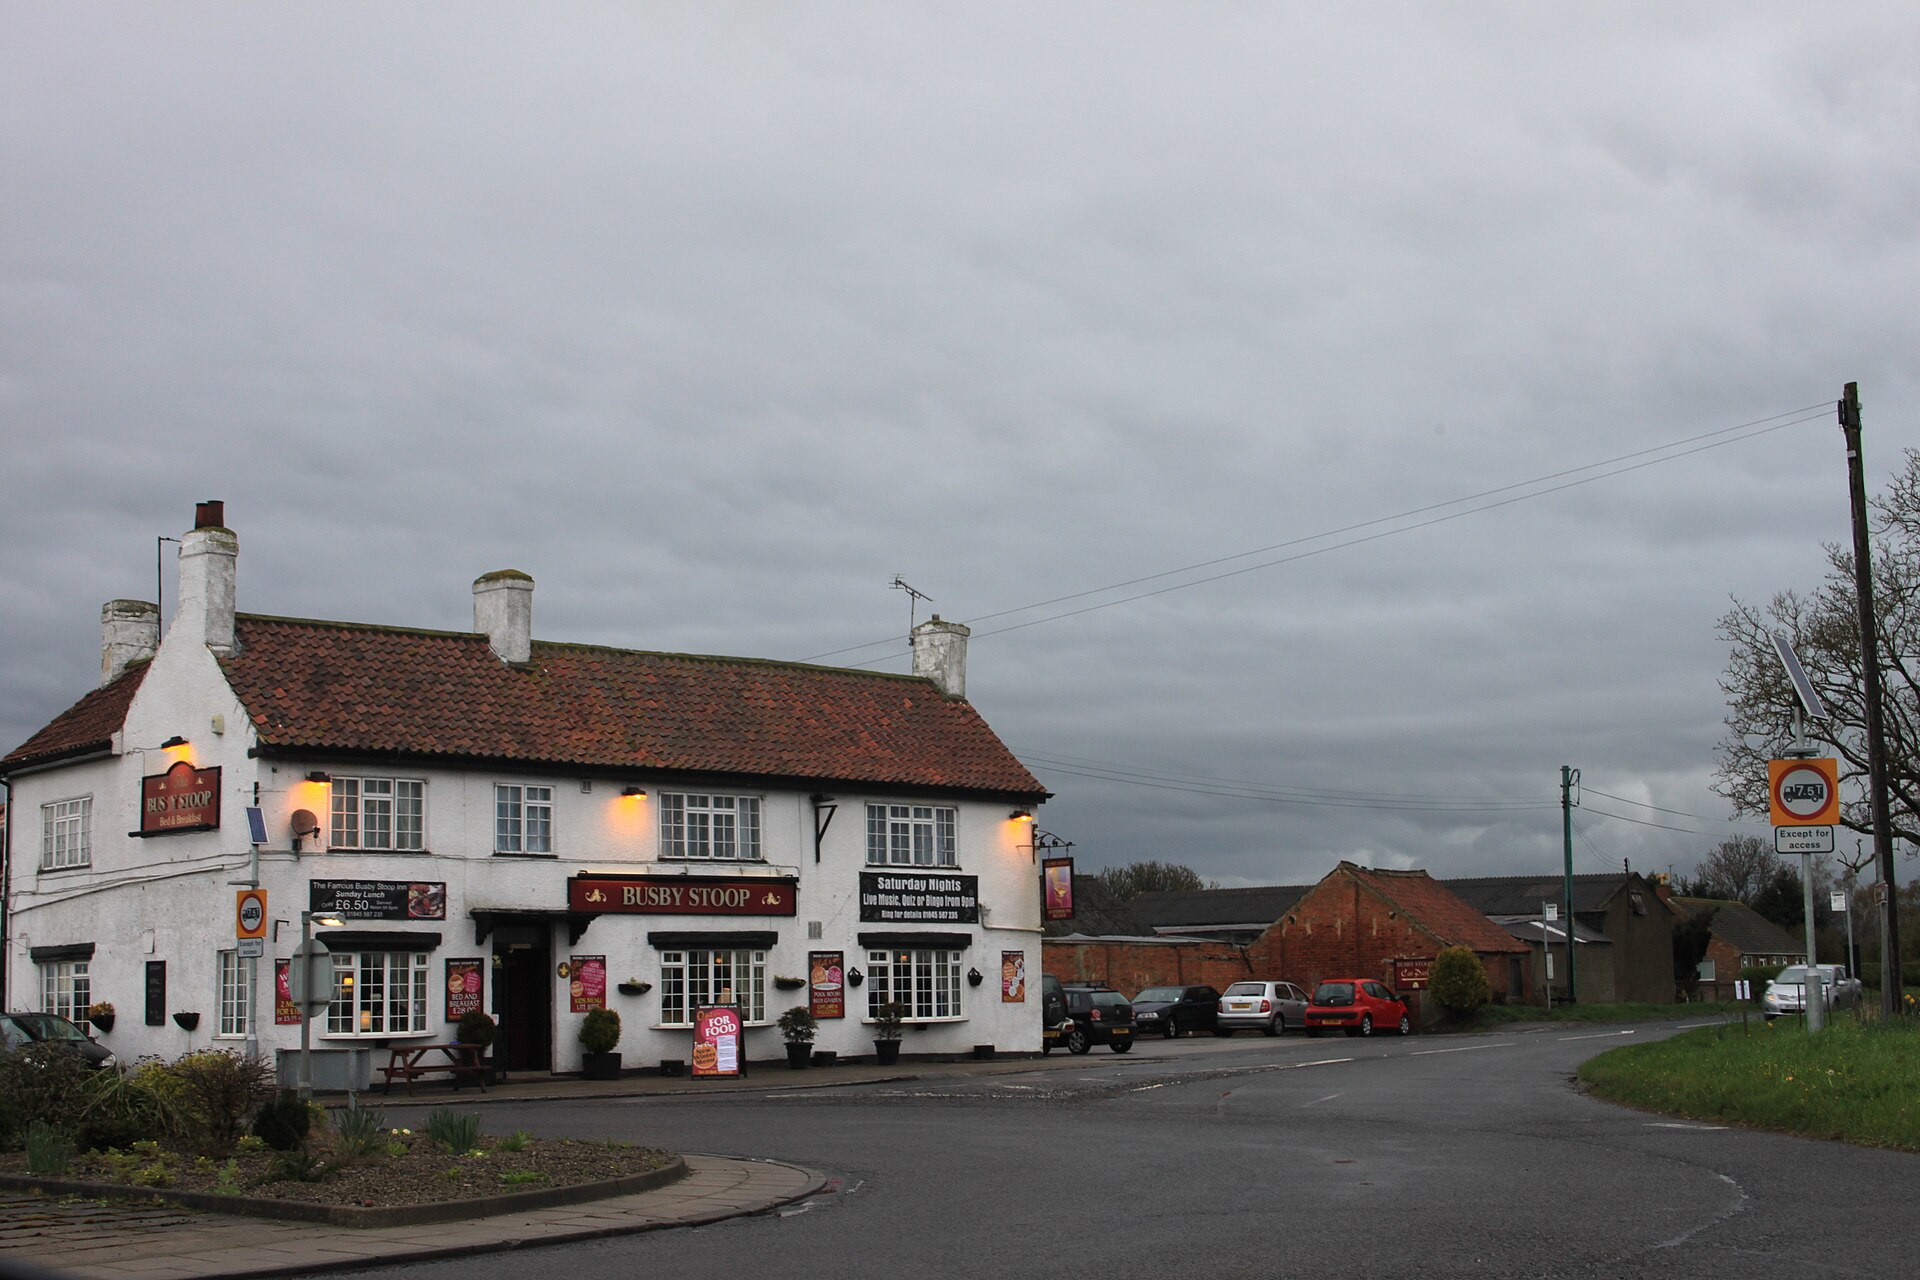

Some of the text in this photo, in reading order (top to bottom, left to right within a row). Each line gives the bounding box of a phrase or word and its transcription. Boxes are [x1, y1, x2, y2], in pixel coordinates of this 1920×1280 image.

[173, 774, 188, 789] The
[1796, 784, 1822, 796] 7.5T
[179, 790, 213, 809] STOOP
[160, 816, 170, 827] Bed
[176, 813, 202, 826] Breakfast
[1780, 829, 1829, 839] Except for
[313, 882, 326, 890] The
[355, 883, 376, 891] Busby
[878, 877, 962, 892] Saturday Nights
[336, 890, 362, 899] Sunday
[622, 886, 751, 908] BUSBY STOOP
[335, 899, 369, 911] £6.50
[863, 893, 878, 906] Live
[902, 895, 917, 907] Quiz
[917, 896, 925, 906] or
[925, 895, 944, 908] Bingo
[944, 896, 960, 907] from
[961, 896, 975, 909] 9pm
[881, 910, 894, 919] Ring
[894, 910, 904, 919] for
[904, 911, 922, 919] details
[1400, 968, 1413, 977] Car
[451, 993, 478, 1001] BED AND
[449, 1000, 480, 1008] BREAKFAST
[276, 1008, 289, 1016] FOR
[708, 1015, 731, 1028] FOR
[705, 1023, 737, 1037] FOOD
[694, 1052, 716, 1060] Winter
[696, 1057, 715, 1065] Menu
